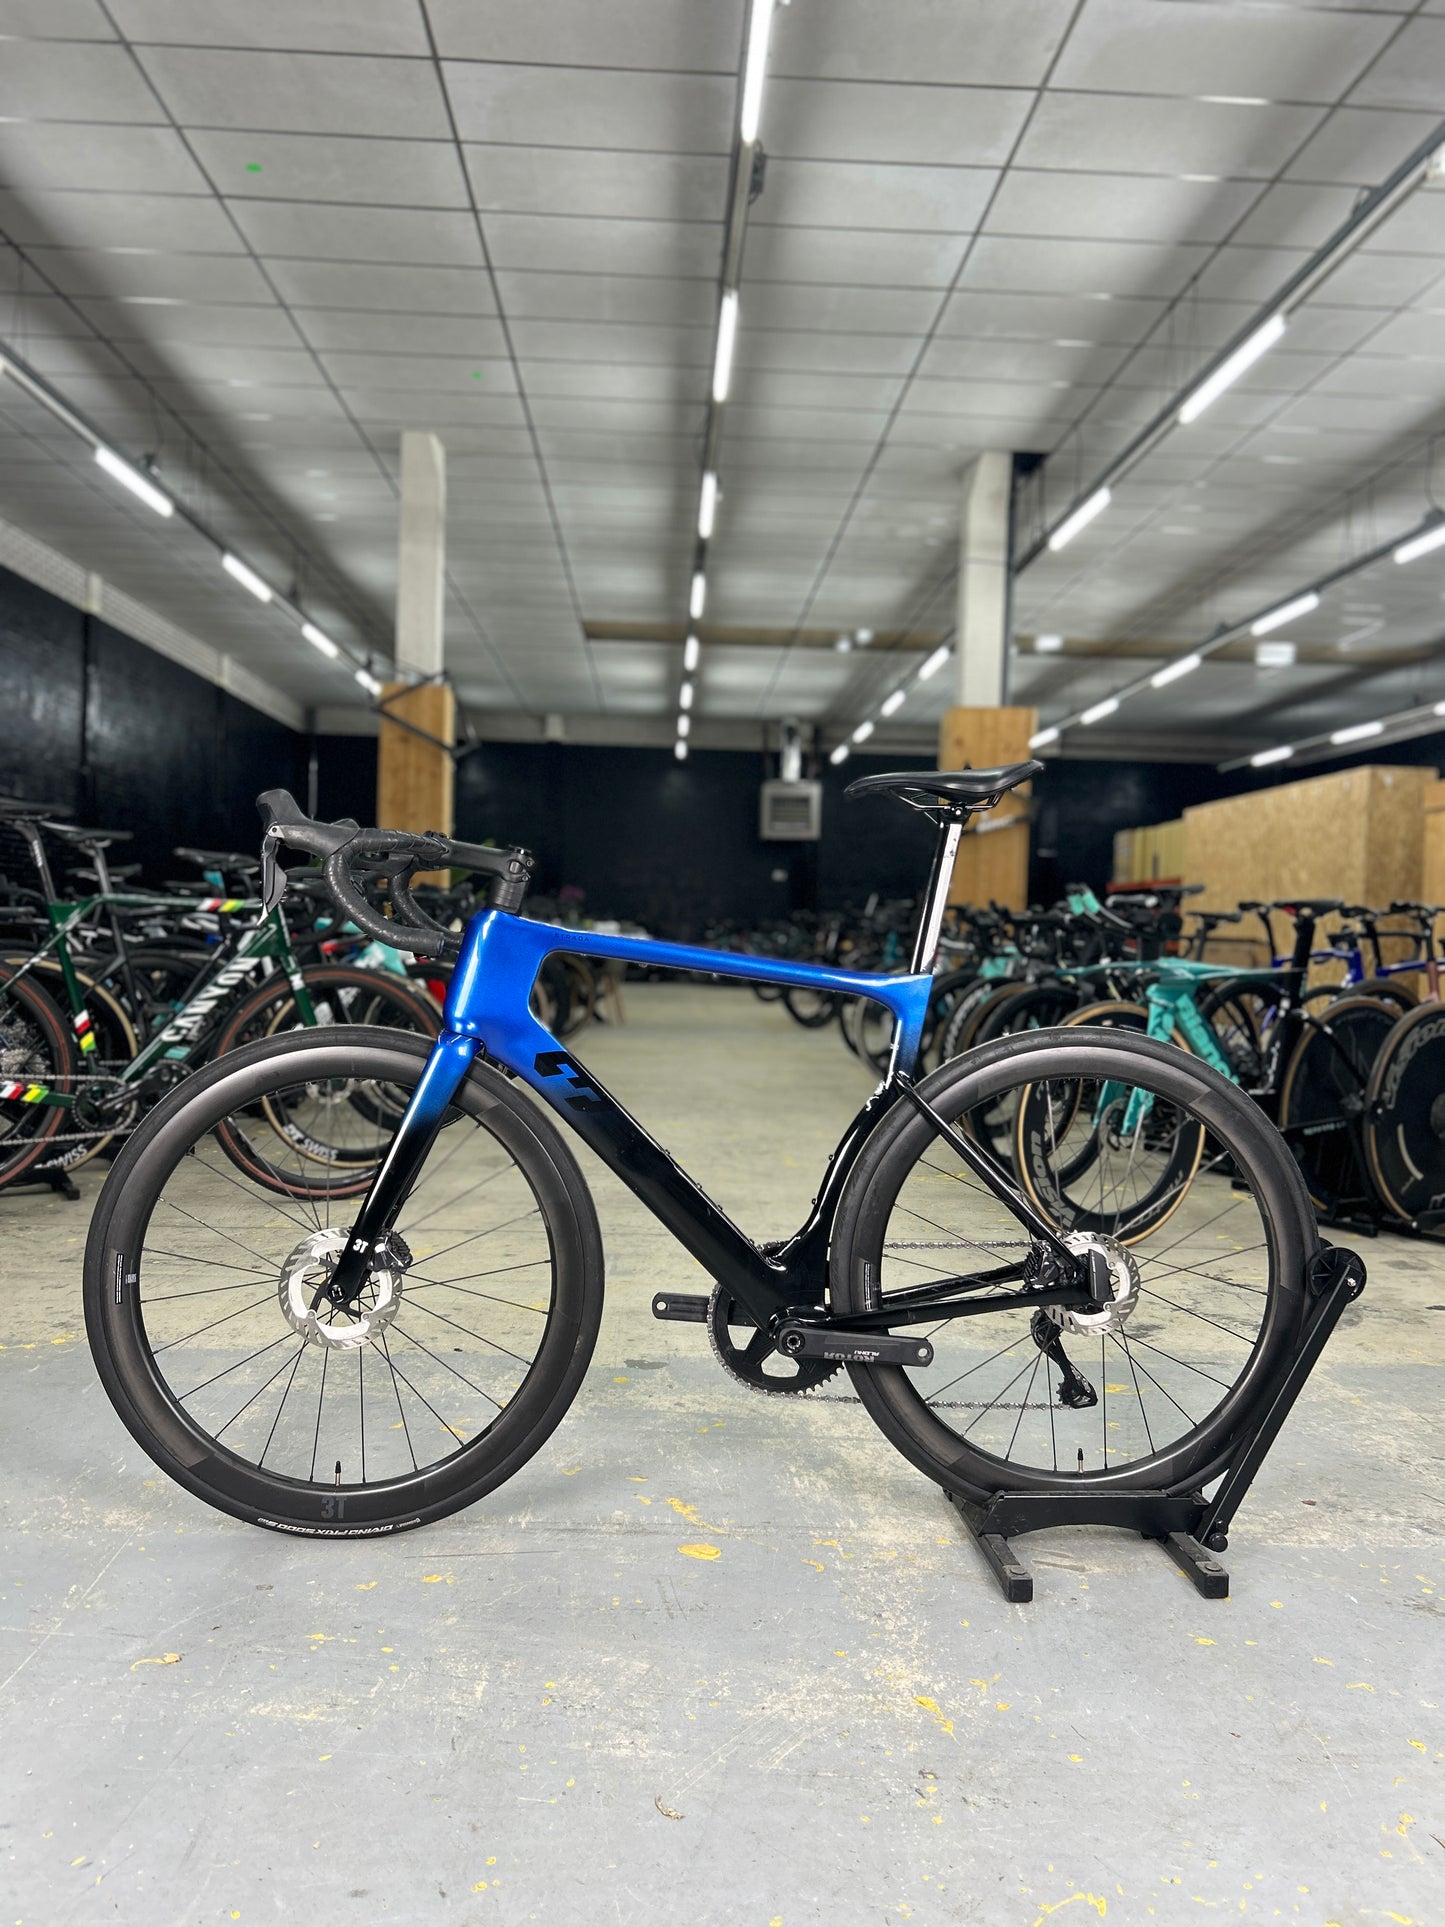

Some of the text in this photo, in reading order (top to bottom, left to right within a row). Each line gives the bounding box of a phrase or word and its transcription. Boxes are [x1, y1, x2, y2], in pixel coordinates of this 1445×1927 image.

[159, 957, 261, 1042] CANYON
[301, 1138, 339, 1161] SWISS
[352, 1238, 369, 1254] 3T
[824, 1352, 875, 1362] ROTOR
[321, 1495, 347, 1520] 3T
